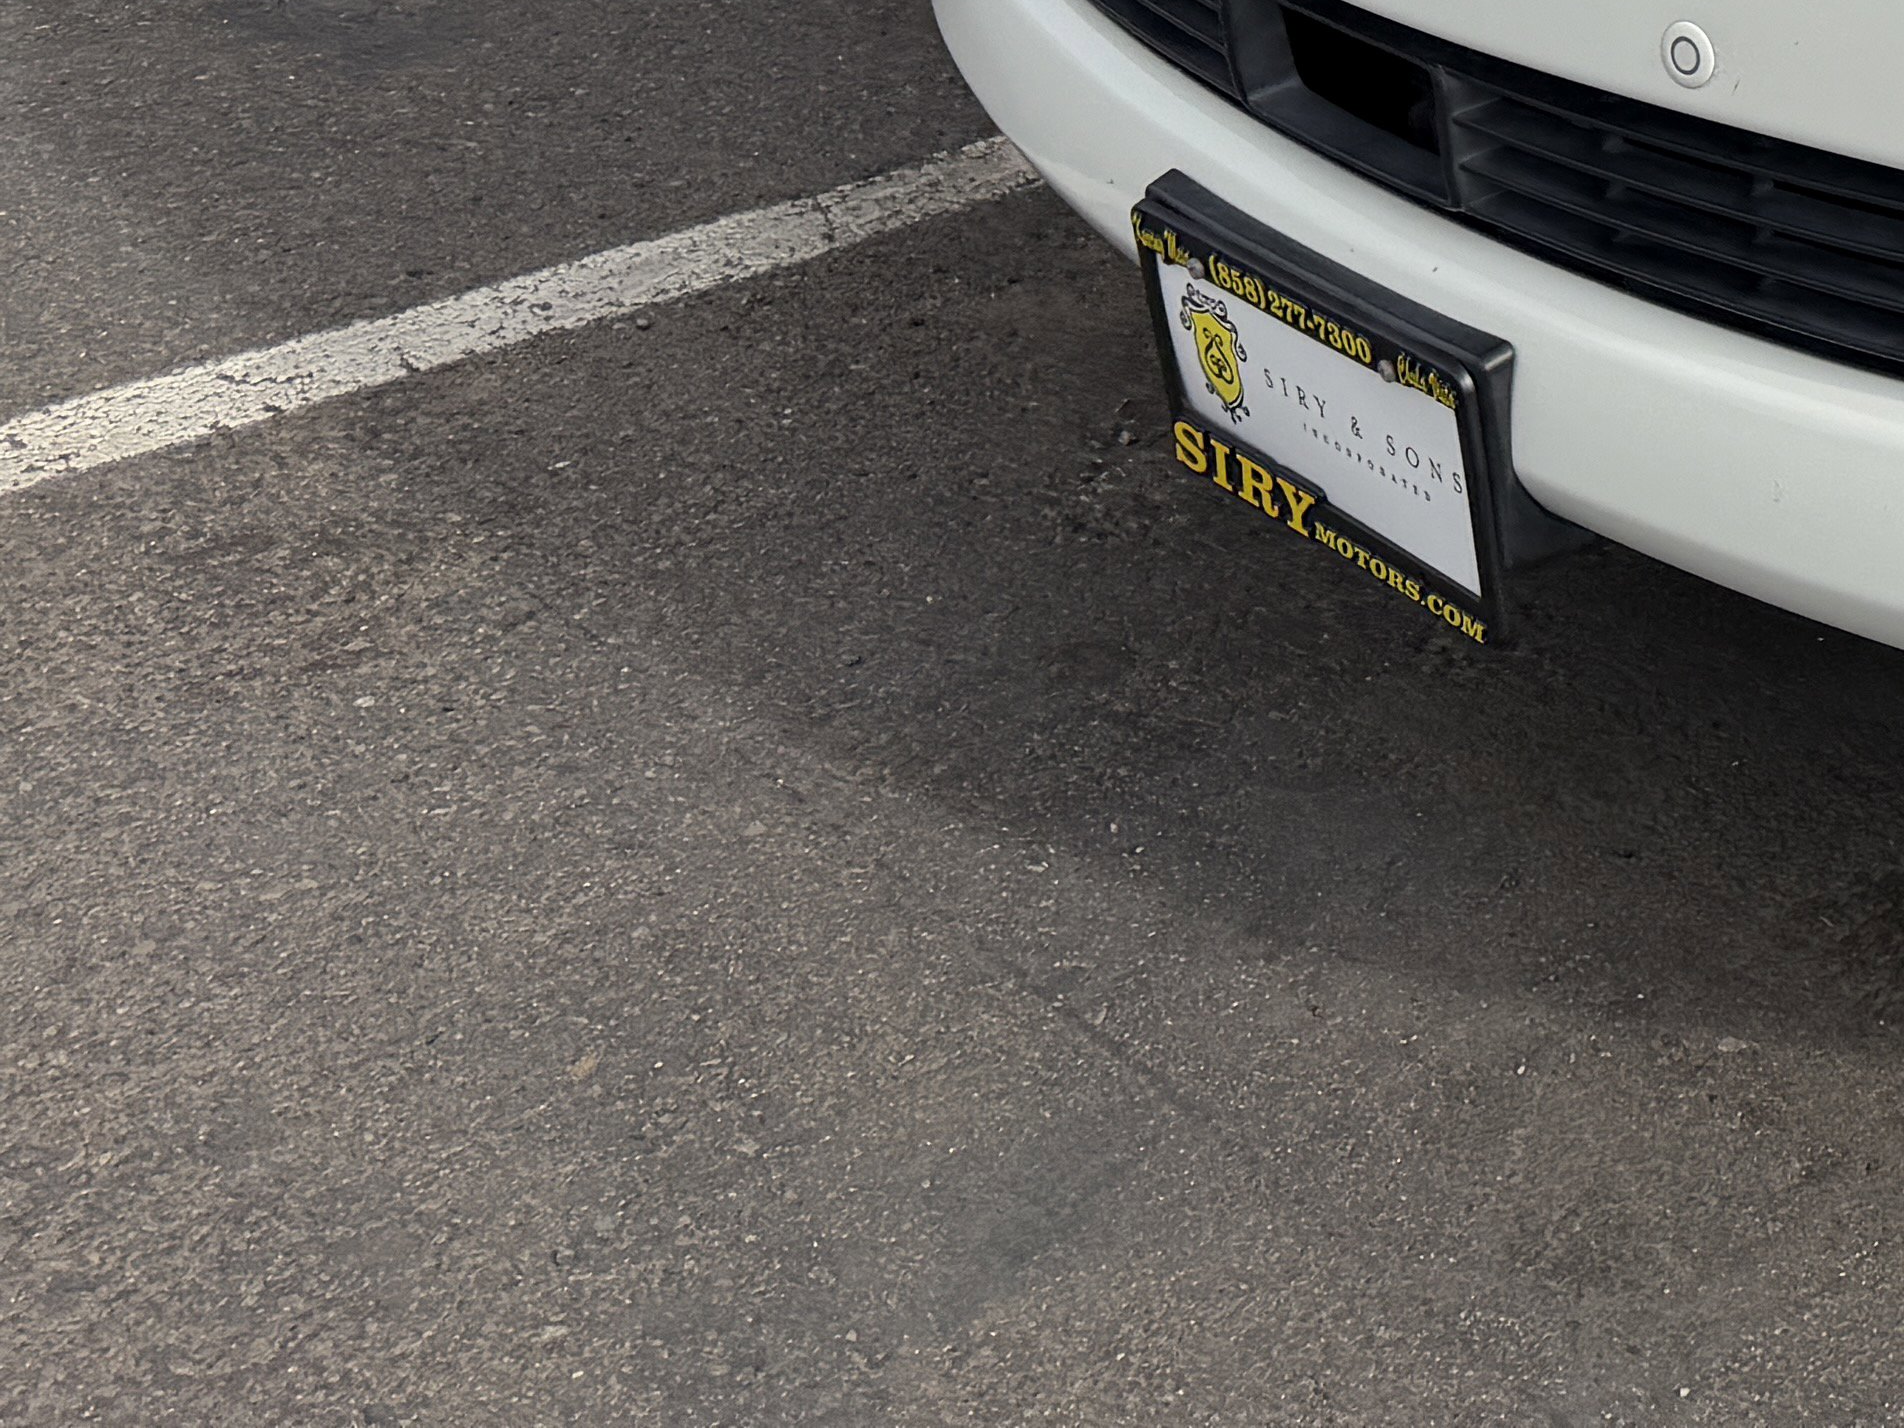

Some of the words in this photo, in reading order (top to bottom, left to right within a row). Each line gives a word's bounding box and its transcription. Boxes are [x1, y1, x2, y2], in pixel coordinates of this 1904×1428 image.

[1209, 254, 1267, 310] (858)
[1173, 420, 1316, 537] SIRY
[1263, 368, 1326, 419] SIRY
[1350, 415, 1363, 439] &
[1386, 434, 1463, 494] SONS
